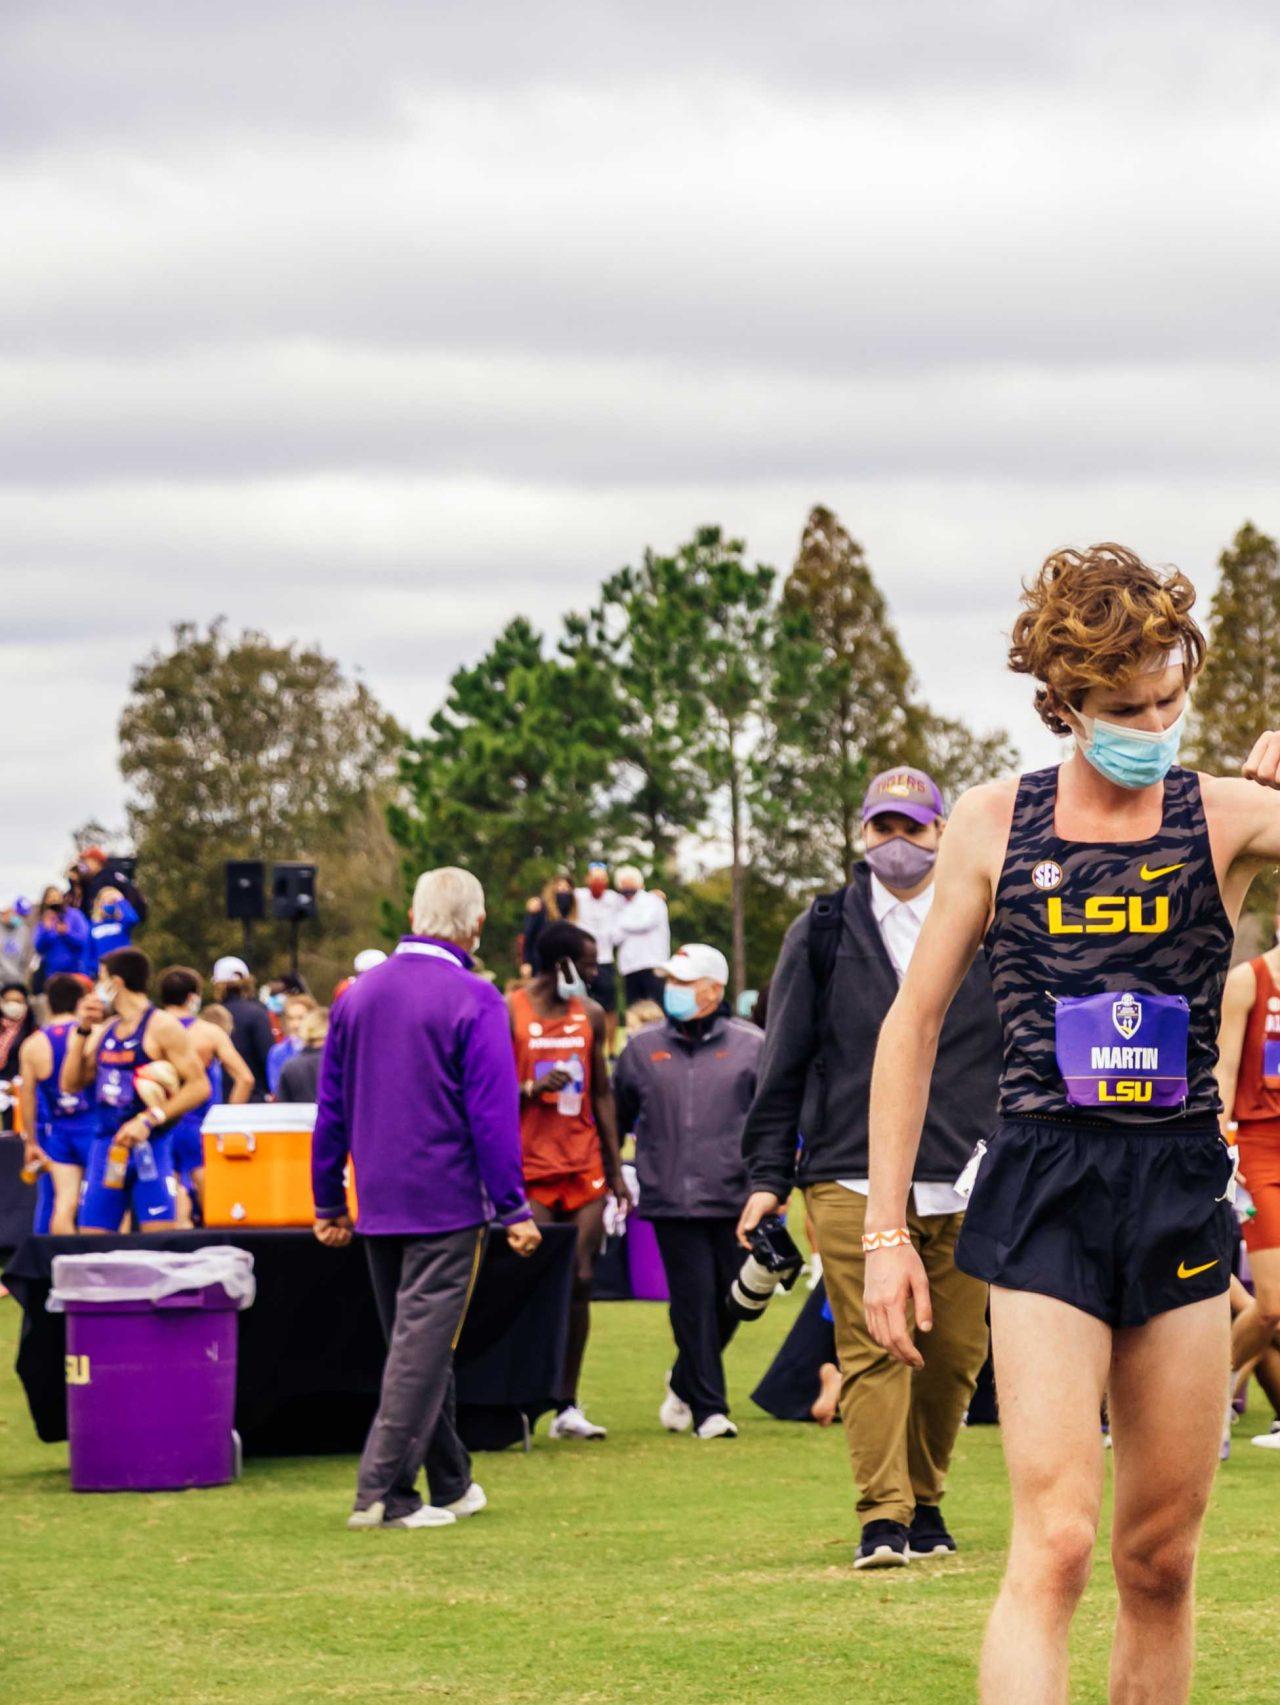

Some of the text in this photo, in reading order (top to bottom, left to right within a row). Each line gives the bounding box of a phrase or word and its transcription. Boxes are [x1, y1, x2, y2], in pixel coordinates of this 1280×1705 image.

[1034, 861, 1061, 887] SEC
[1047, 896, 1169, 934] LSU
[1091, 1047, 1158, 1070] MARTIN
[1098, 1080, 1152, 1102] LSU
